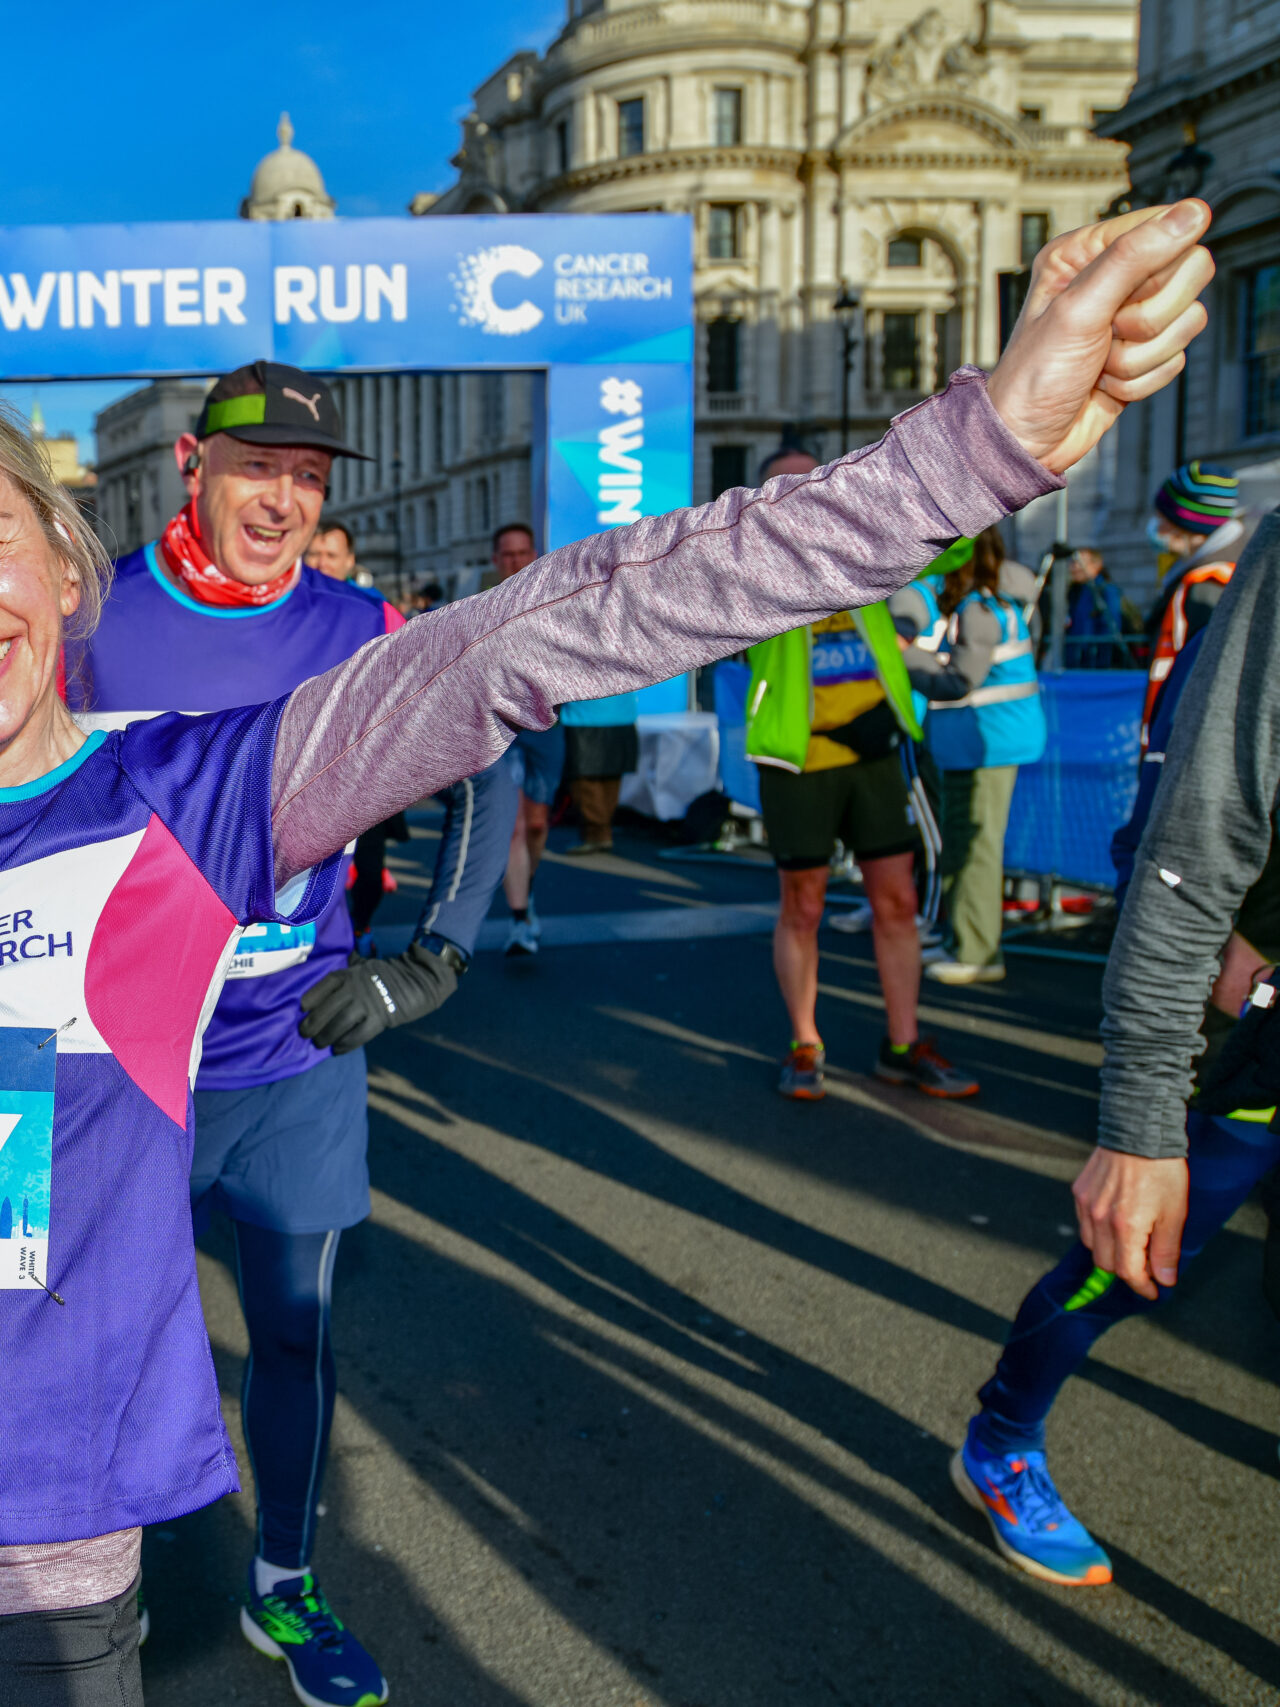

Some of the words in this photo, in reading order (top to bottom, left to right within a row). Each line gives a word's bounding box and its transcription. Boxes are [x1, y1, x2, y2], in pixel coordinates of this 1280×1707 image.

[554, 252, 649, 276] CANCER
[273, 263, 409, 324] RUN
[554, 276, 673, 301] RESEARCH
[554, 301, 588, 325] UK
[813, 643, 867, 671] 2617
